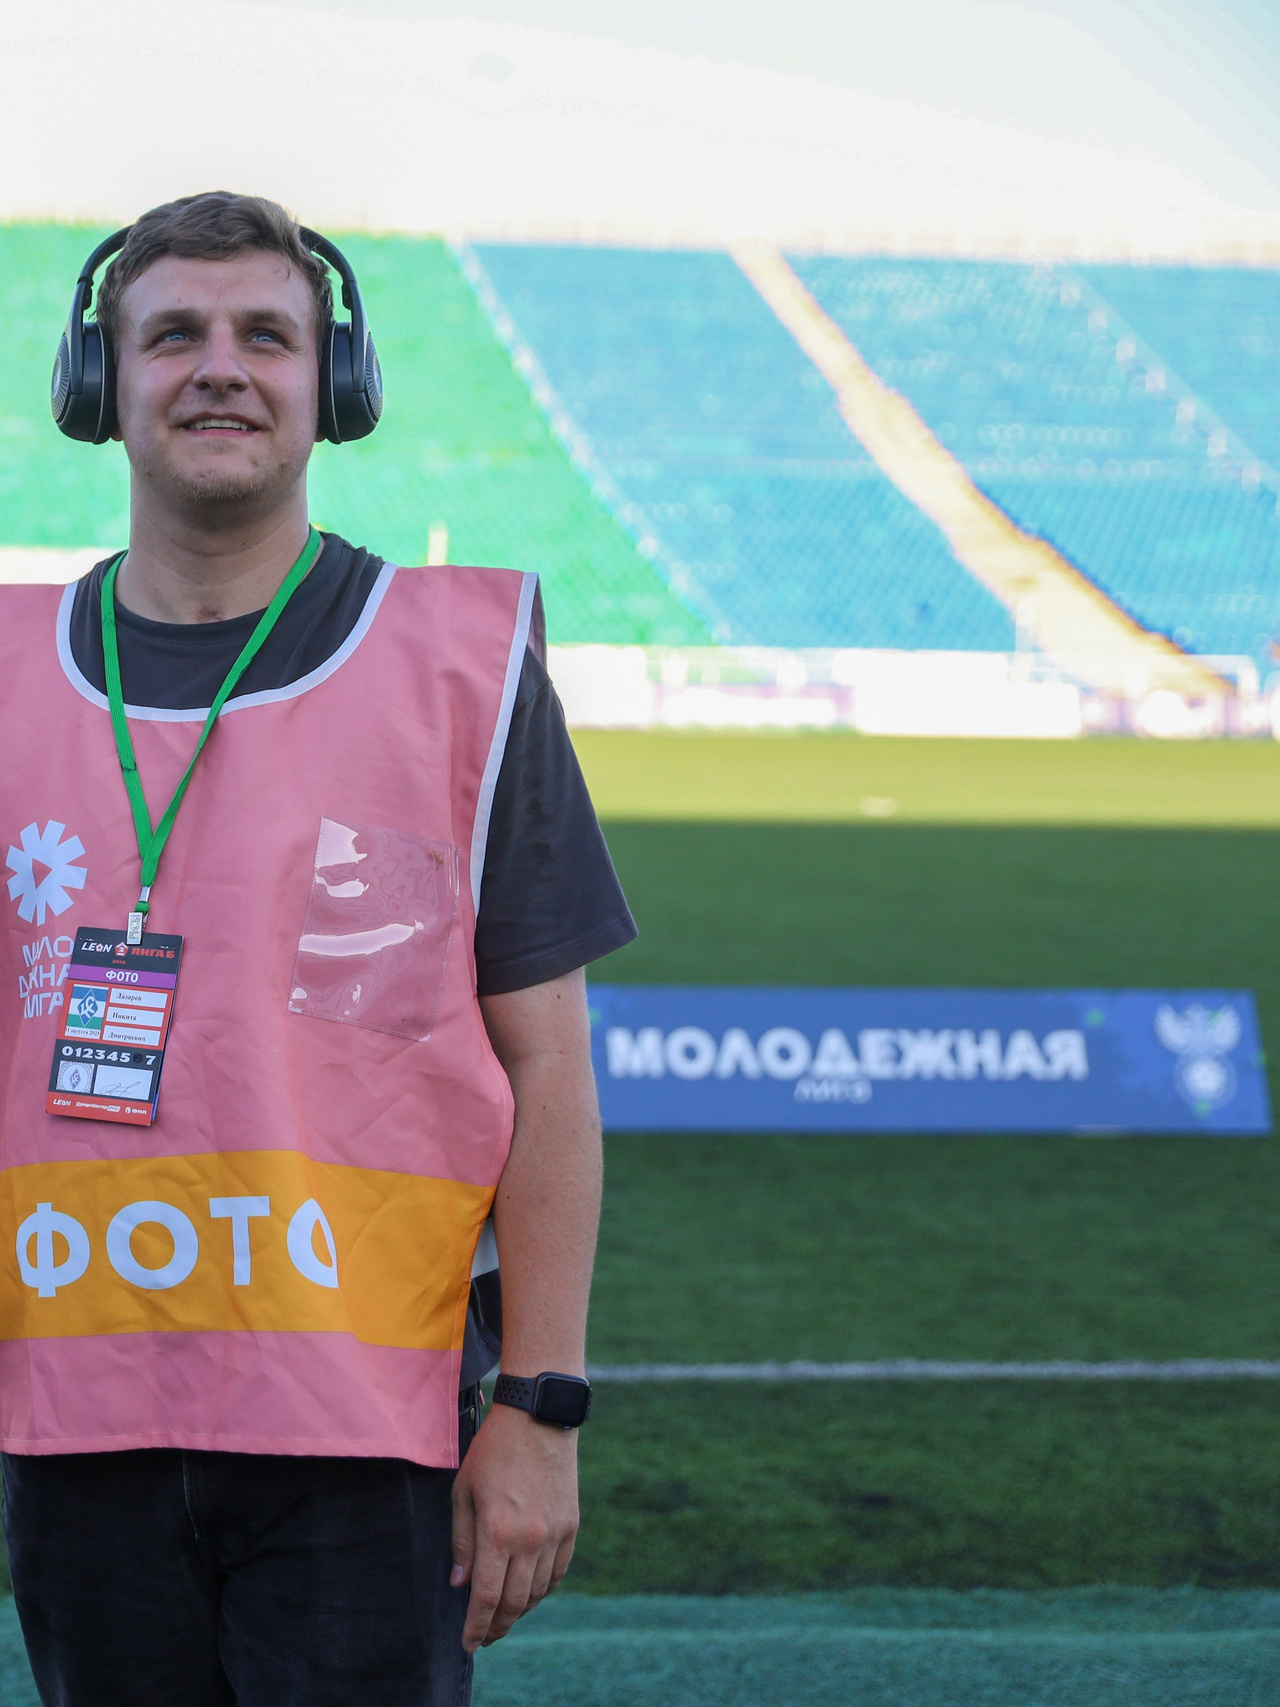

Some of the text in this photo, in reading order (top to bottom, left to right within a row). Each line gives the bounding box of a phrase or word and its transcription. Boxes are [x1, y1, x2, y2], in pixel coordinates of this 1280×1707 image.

[81, 942, 112, 953] LEON
[131, 947, 165, 958] ЛИГА
[165, 950, 175, 959] Б
[105, 970, 139, 983] ФОТО
[112, 1012, 137, 1021] Никита
[605, 1026, 1089, 1081] МОЛОДЕЖНАЯ
[16, 1196, 339, 1298] ФОТО
